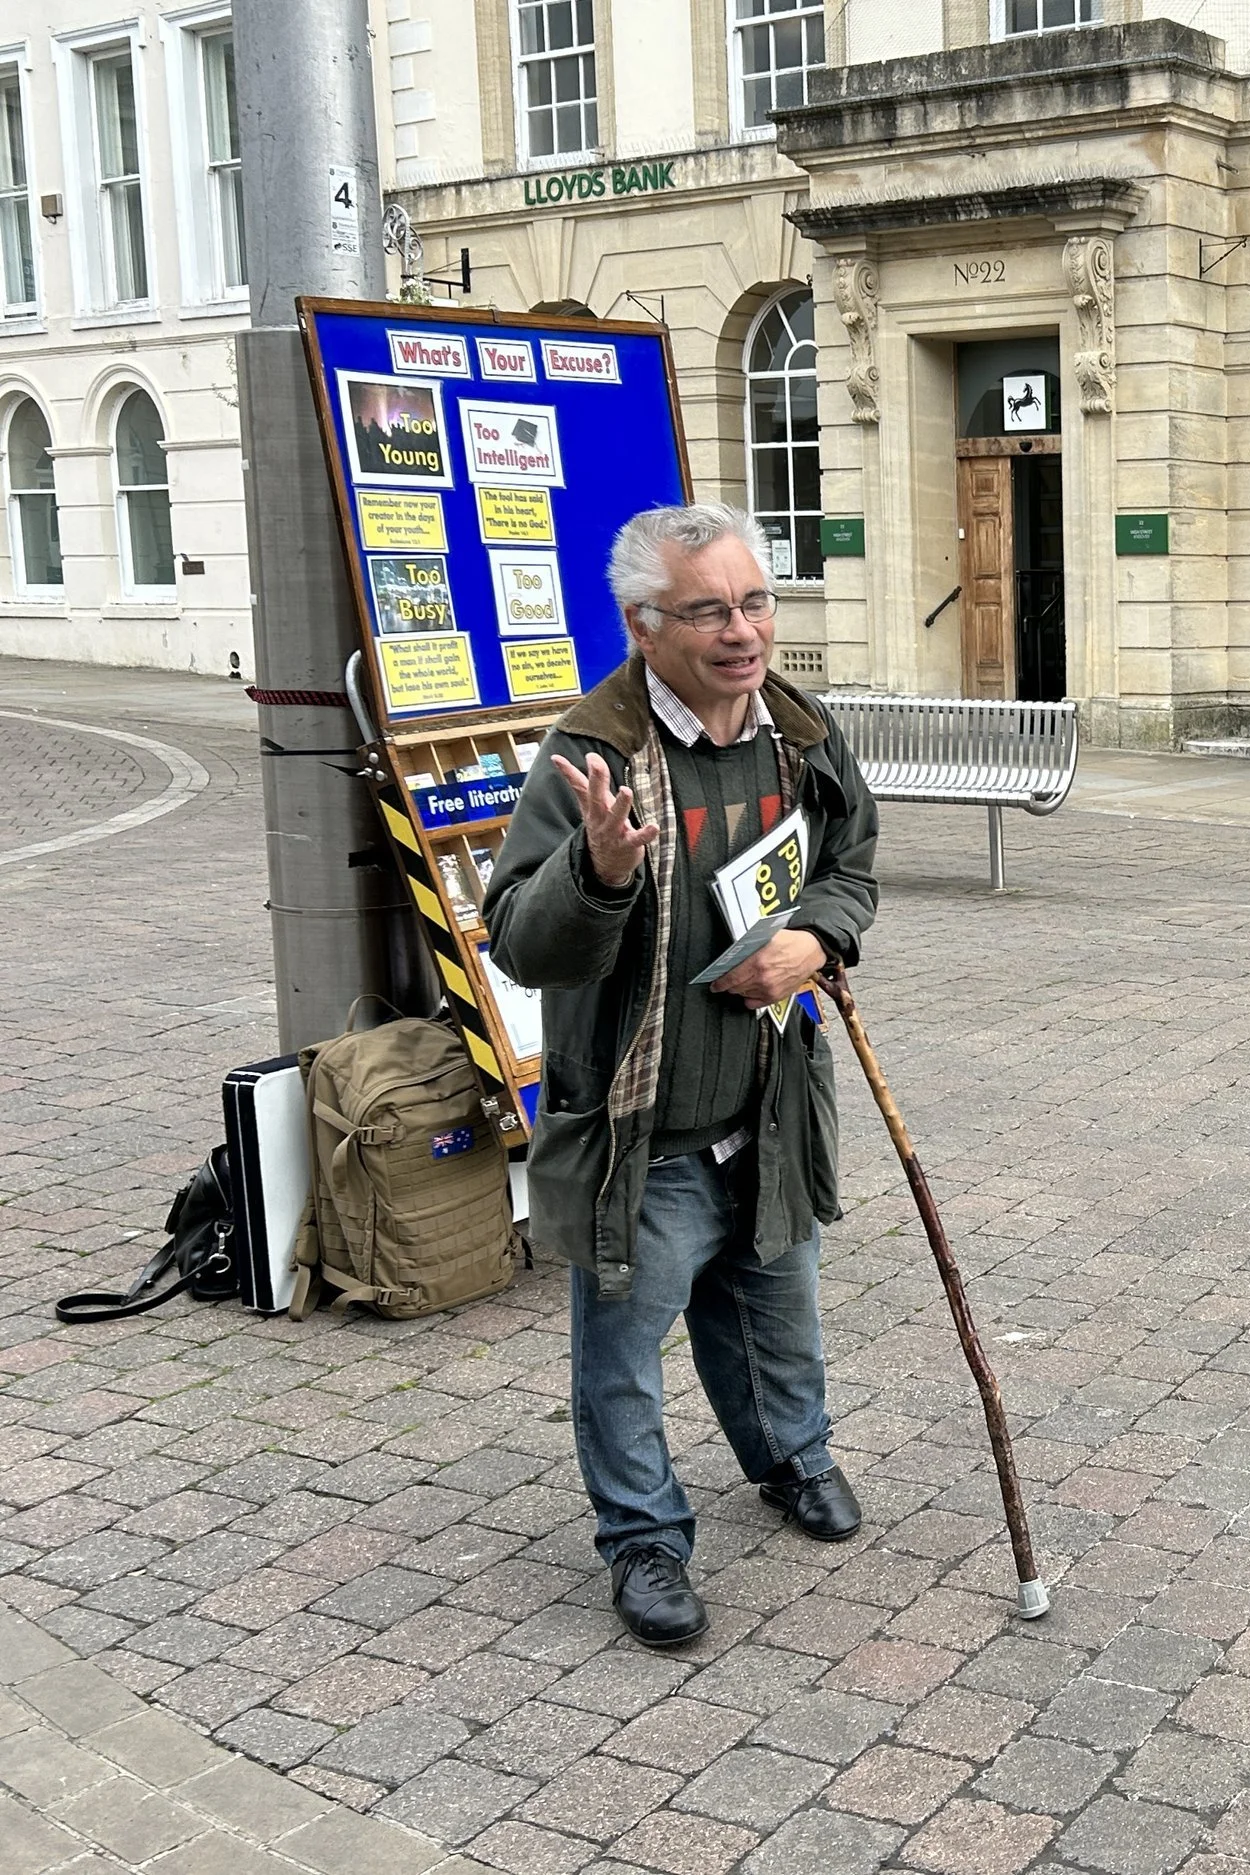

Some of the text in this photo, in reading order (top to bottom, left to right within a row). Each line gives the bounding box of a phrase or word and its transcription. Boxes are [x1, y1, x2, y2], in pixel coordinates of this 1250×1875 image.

[524, 161, 675, 205] LLOYDS BANK
[334, 182, 353, 209] 4
[342, 243, 358, 253] SSE
[398, 340, 611, 374] What's Your Excuse?
[400, 413, 433, 435] Too
[474, 422, 500, 441] Too
[378, 443, 439, 472] Young
[477, 448, 550, 471] Intelligent
[362, 497, 402, 508] Remember
[420, 502, 436, 511] your
[484, 491, 544, 503] The fool has said
[503, 505, 514, 514] his
[368, 512, 394, 521] creator
[404, 512, 416, 521] the
[418, 513, 434, 524] days
[510, 518, 516, 528] is
[377, 524, 384, 533] of
[385, 526, 402, 535] your
[405, 563, 441, 586] Too
[512, 569, 542, 590] Too
[399, 599, 446, 625] Busy
[510, 598, 554, 620] Good
[413, 642, 430, 652] shall
[439, 640, 458, 652] profit
[528, 650, 540, 659] say
[552, 646, 568, 655] have
[444, 653, 460, 664] gain
[546, 658, 571, 668] deceive
[399, 670, 412, 679] the
[412, 668, 435, 678] whole
[422, 682, 432, 690] his
[427, 785, 522, 815] Free literatu
[756, 863, 780, 918] Too
